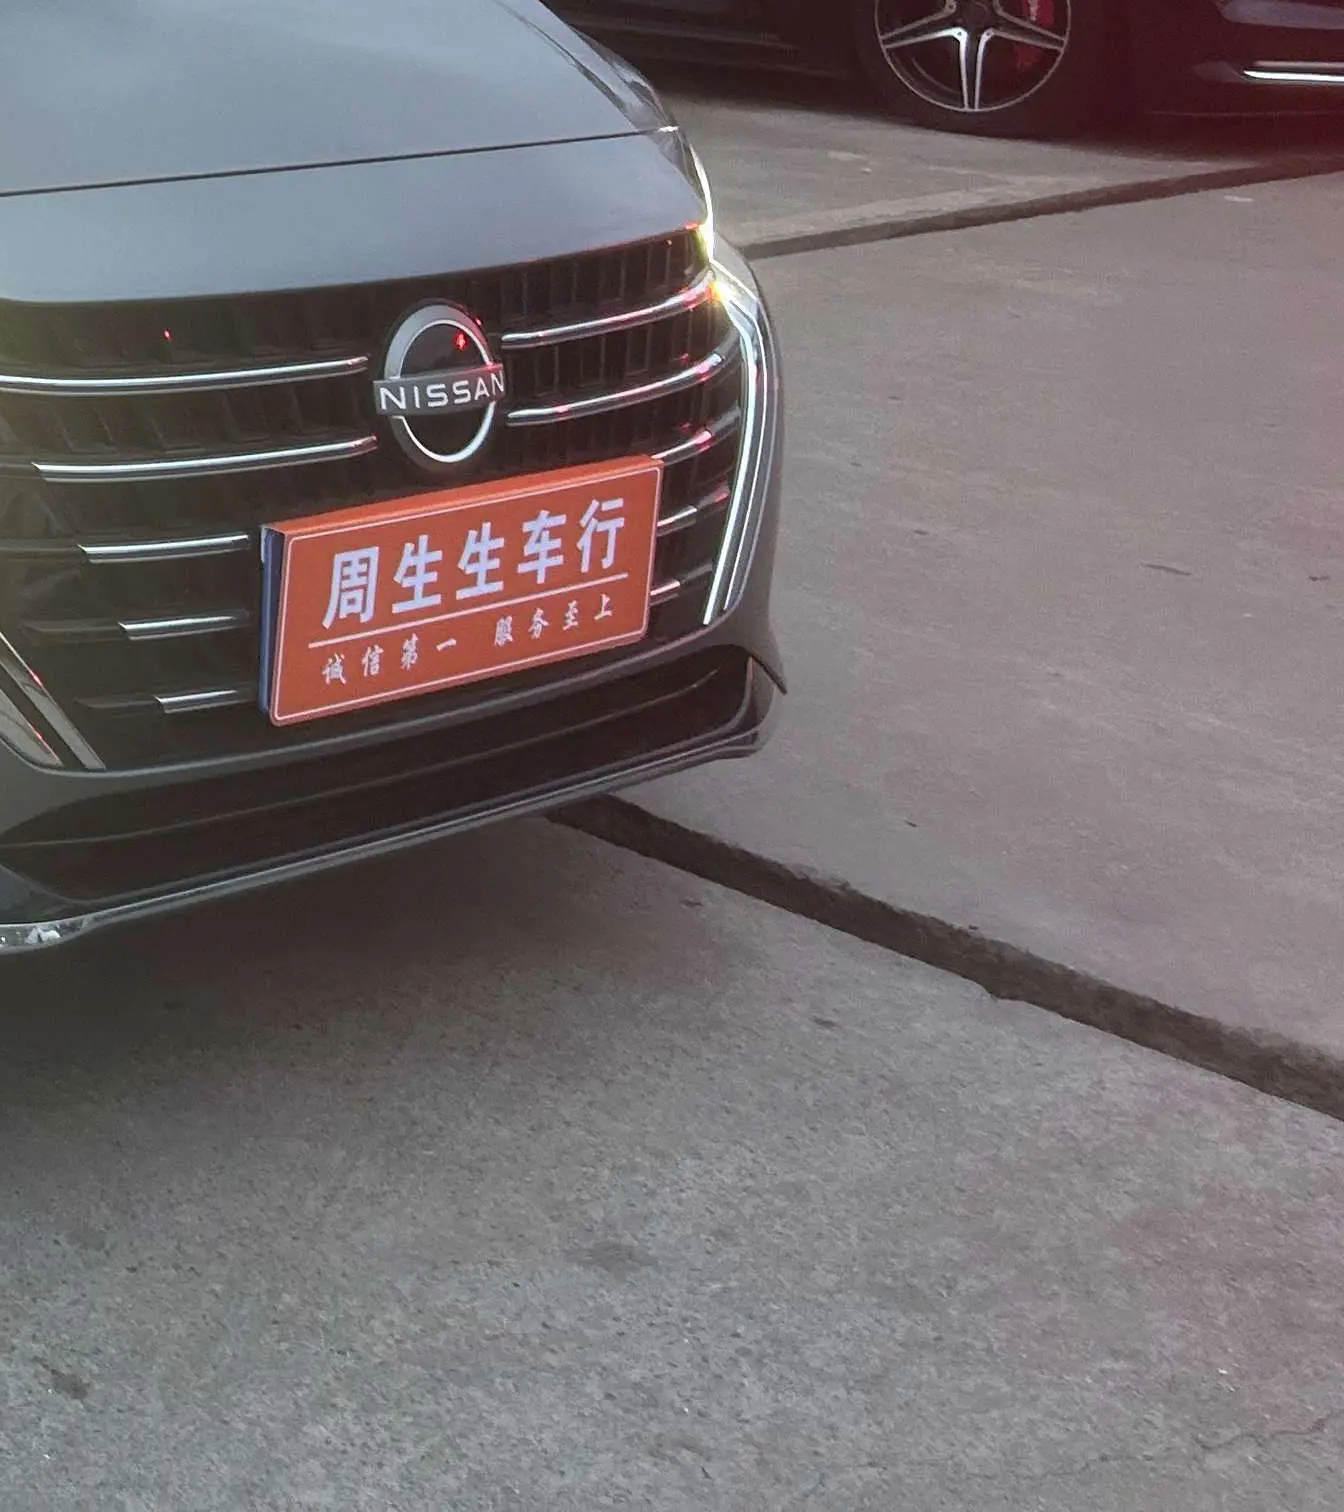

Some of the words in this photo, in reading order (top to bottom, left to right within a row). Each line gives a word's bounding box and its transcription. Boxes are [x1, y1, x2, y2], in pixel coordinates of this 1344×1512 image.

[379, 370, 505, 411] NISSAN
[322, 497, 625, 629] 周生生车行
[321, 635, 458, 685] 诚信第一
[494, 592, 614, 646] 服务至上
